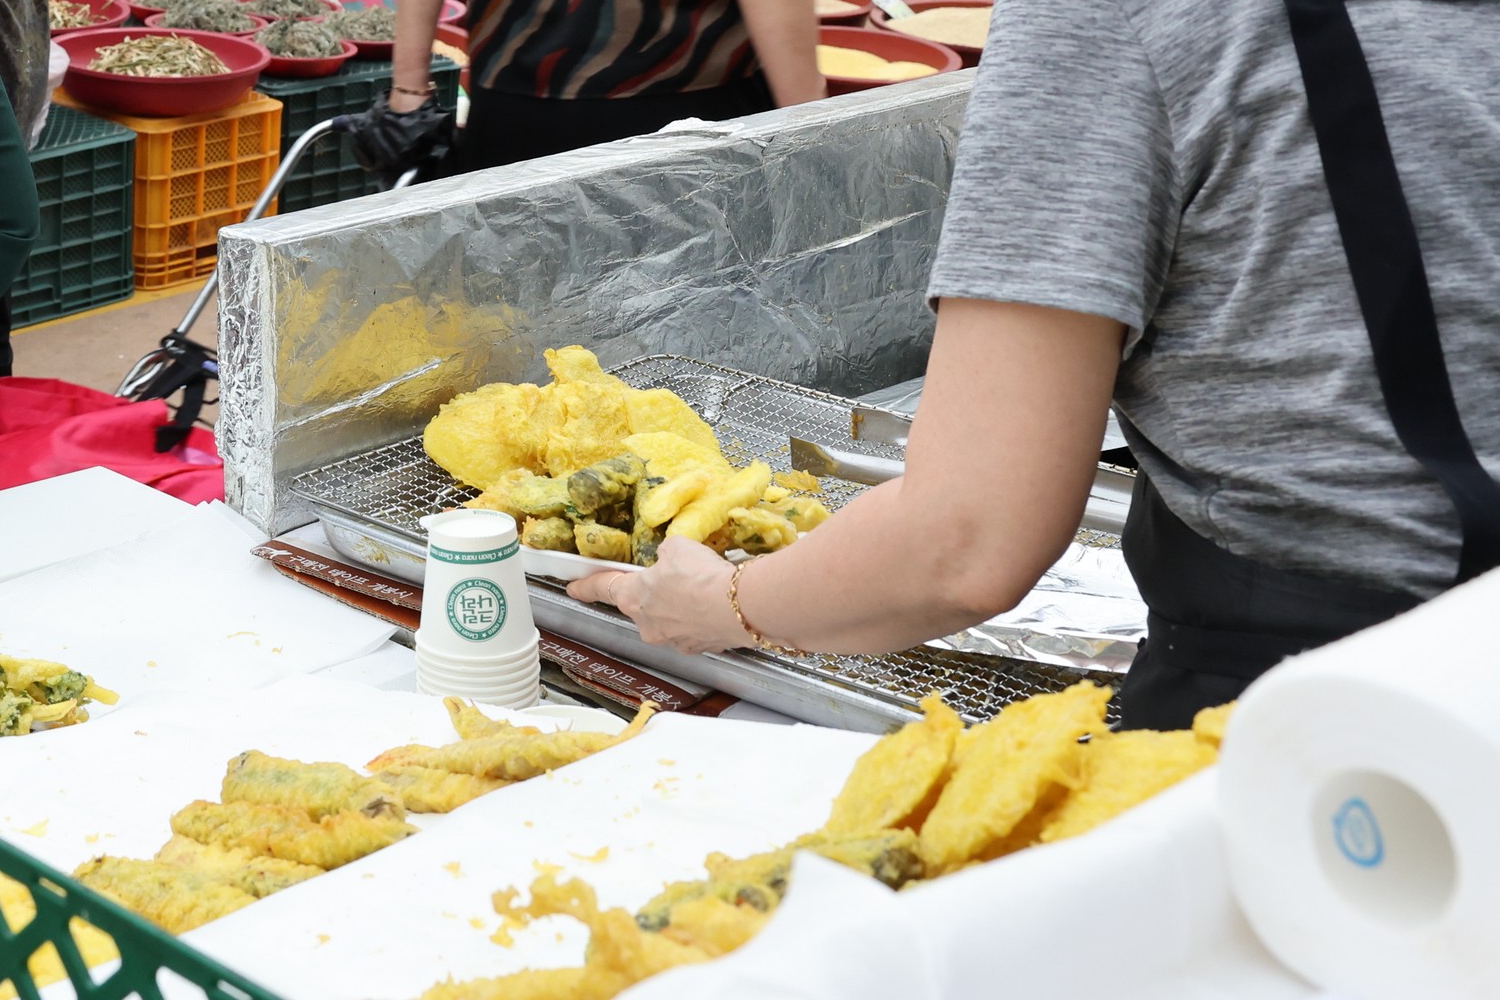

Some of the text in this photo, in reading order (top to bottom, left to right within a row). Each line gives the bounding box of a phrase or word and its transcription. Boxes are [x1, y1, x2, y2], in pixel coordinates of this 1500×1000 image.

[289, 554, 414, 599] 구매전 테이프 개봉시
[541, 640, 590, 665] 구매전
[588, 661, 638, 686] 테이프
